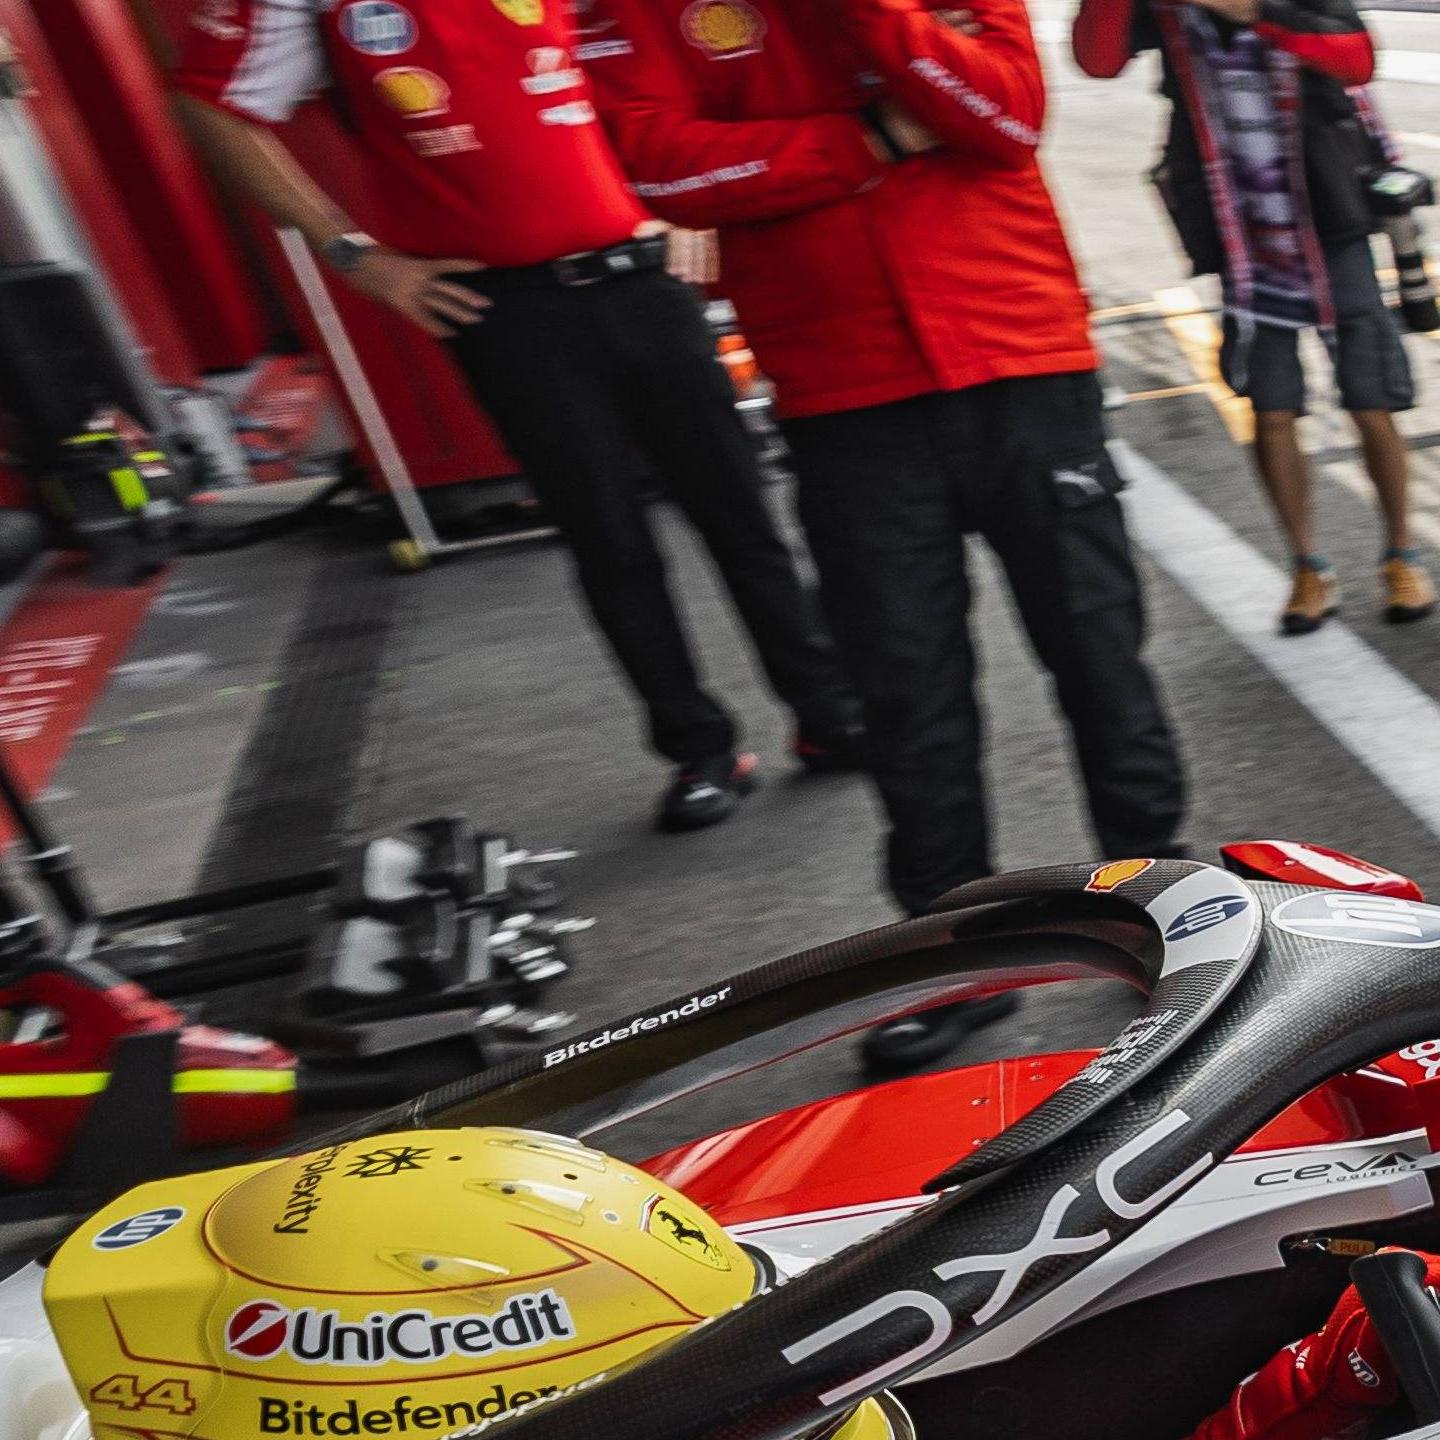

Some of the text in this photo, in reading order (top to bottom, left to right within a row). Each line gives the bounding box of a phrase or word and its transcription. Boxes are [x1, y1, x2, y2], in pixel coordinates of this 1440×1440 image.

[543, 987, 733, 1068] Bitdefender
[292, 1293, 569, 1362] UniCredit
[90, 1374, 196, 1415] 44
